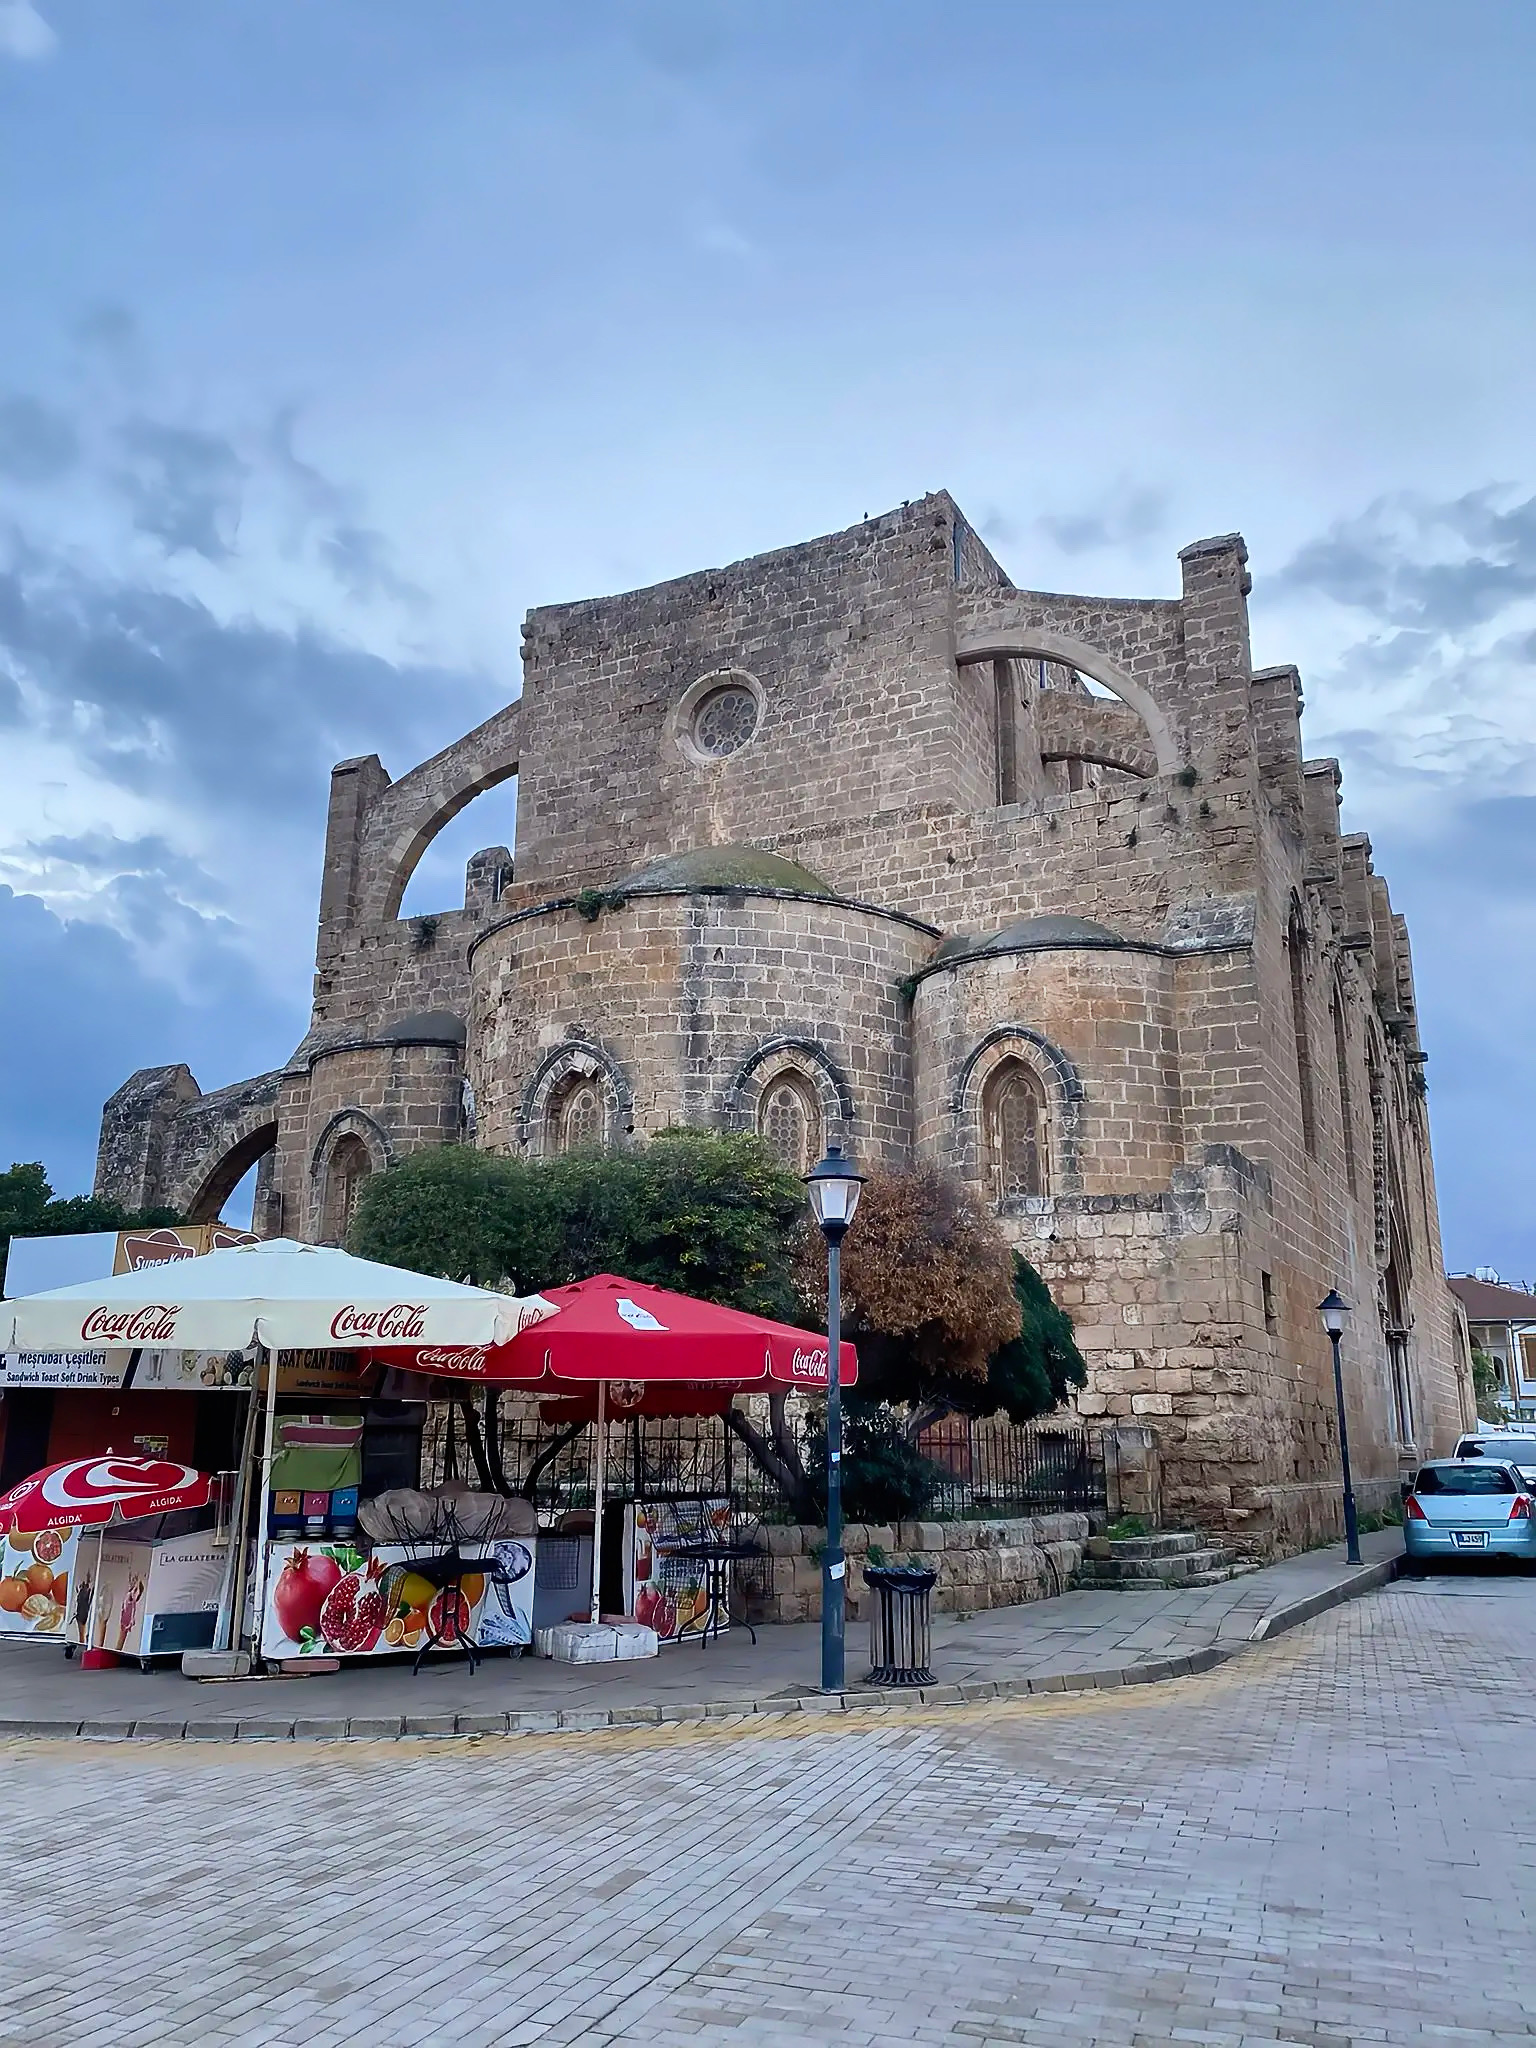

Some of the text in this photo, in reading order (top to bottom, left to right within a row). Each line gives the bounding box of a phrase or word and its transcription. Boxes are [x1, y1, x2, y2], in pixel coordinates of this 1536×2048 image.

[81, 1305, 183, 1340] Coca-Cola
[331, 1304, 430, 1339] Coca-Cola
[7, 1372, 120, 1386] Sandwich Toast Soft Drink Types
[149, 1496, 181, 1509] ALGIDA
[47, 1514, 80, 1527] ALGIDA
[165, 1553, 225, 1563] LA GELATERIA
